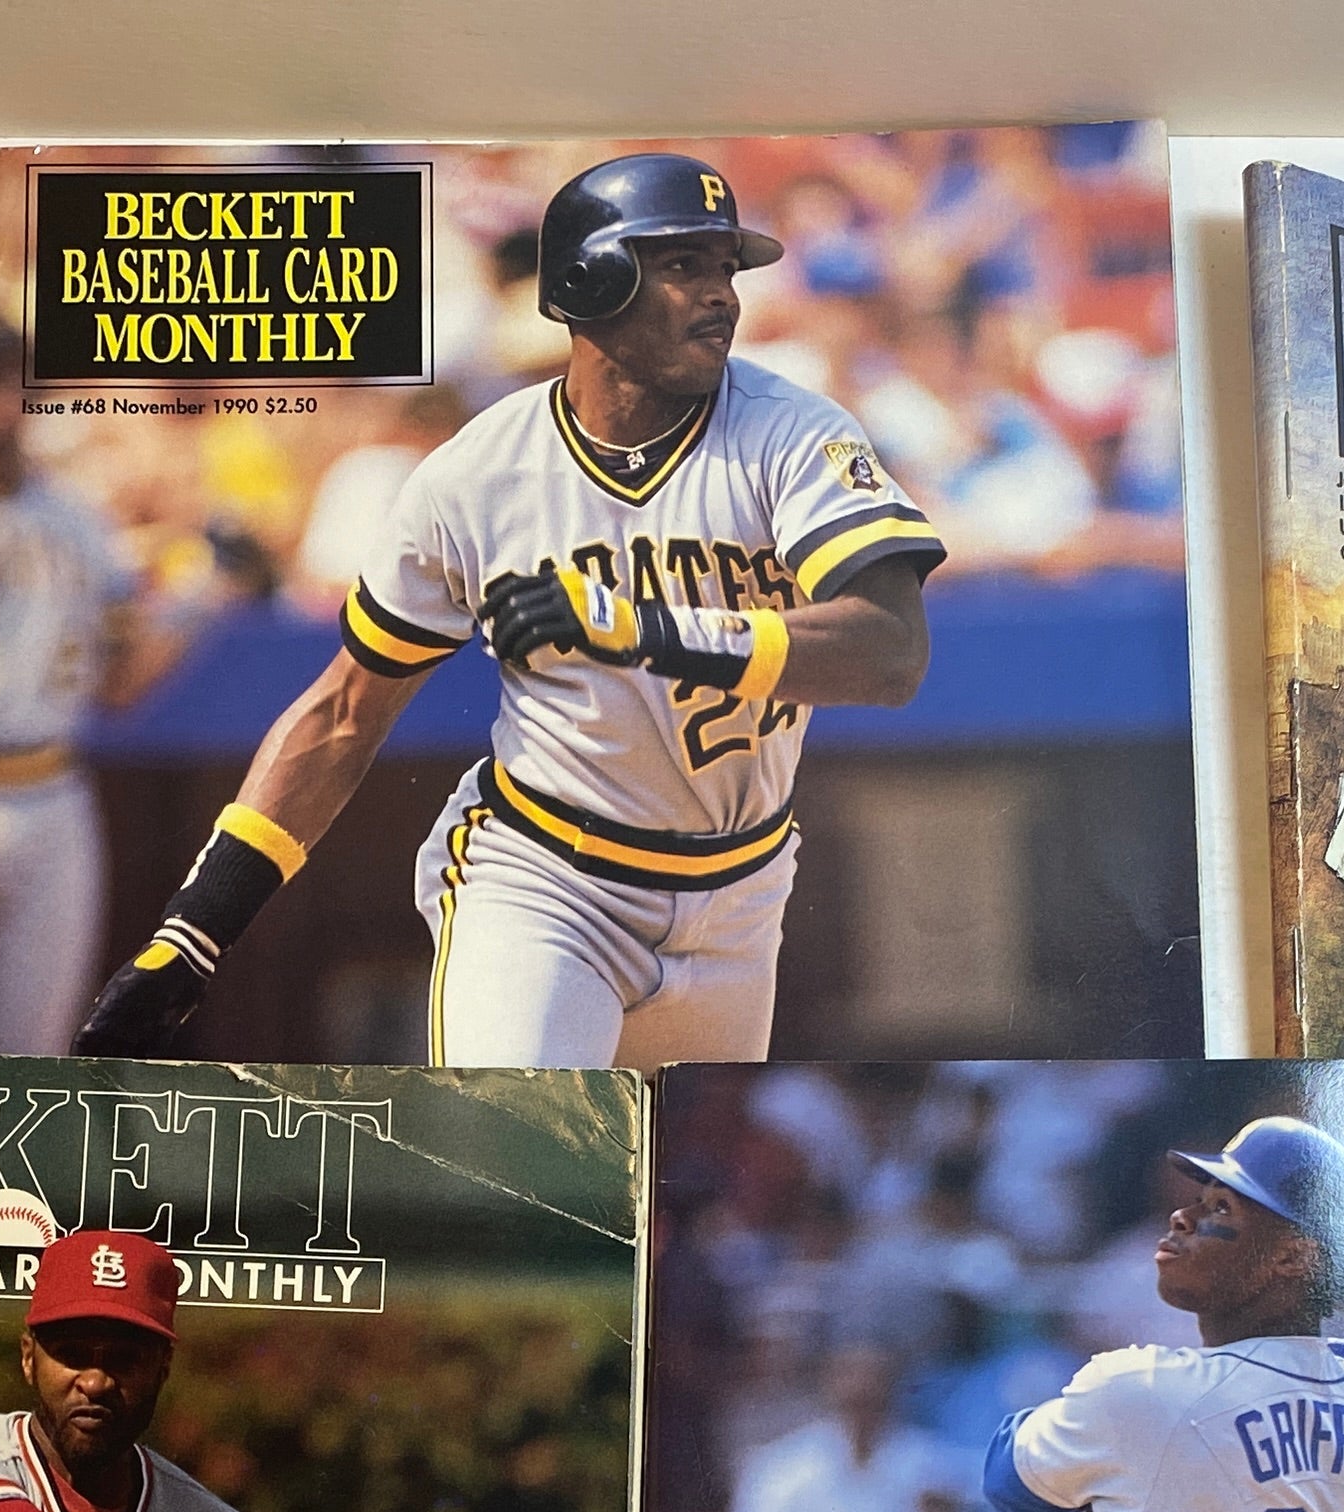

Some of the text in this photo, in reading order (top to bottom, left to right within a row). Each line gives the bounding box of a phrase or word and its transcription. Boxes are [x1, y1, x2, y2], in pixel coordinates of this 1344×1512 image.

[104, 191, 354, 241] BECKETT
[61, 247, 398, 304] BASEBALL CARD
[93, 312, 366, 364] MONTHLY
[22, 397, 318, 415] Issue #68 November 1990 $2.50
[173, 1258, 364, 1304] ONTHLY
